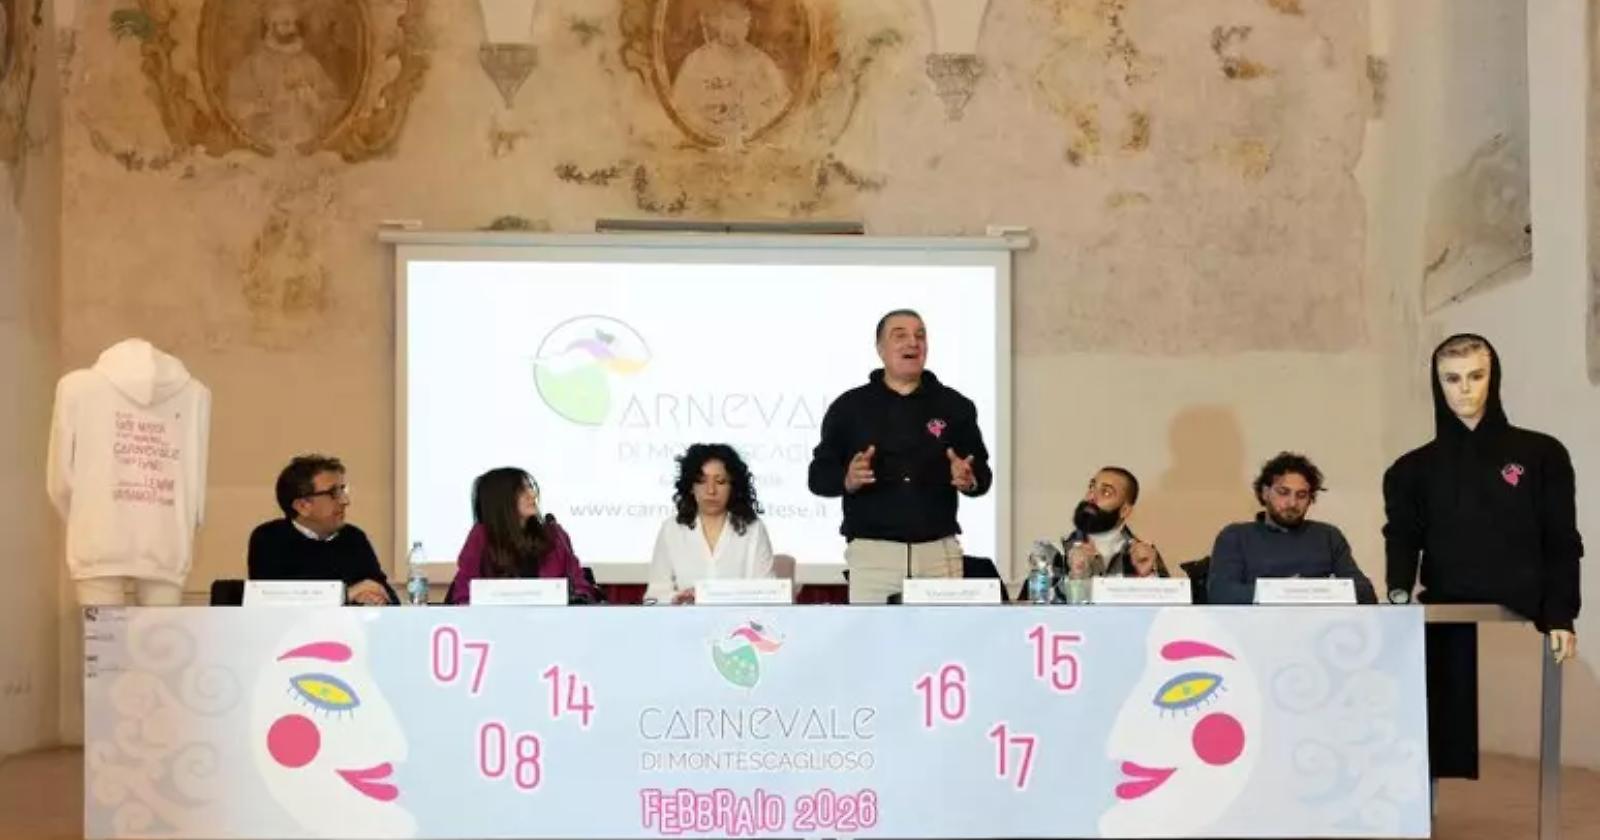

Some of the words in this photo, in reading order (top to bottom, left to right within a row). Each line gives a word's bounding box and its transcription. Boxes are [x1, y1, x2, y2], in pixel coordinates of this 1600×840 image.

[432, 626, 490, 694] 07
[1028, 624, 1081, 691] 15
[542, 664, 595, 727] 14
[914, 663, 967, 728] 16
[479, 721, 541, 790] 08
[641, 751, 662, 771] DI
[668, 750, 876, 771] MONTESCAGLIOSO
[989, 723, 1036, 789] 17
[640, 787, 786, 837] FEBBRAIO
[793, 788, 878, 832] 2026
